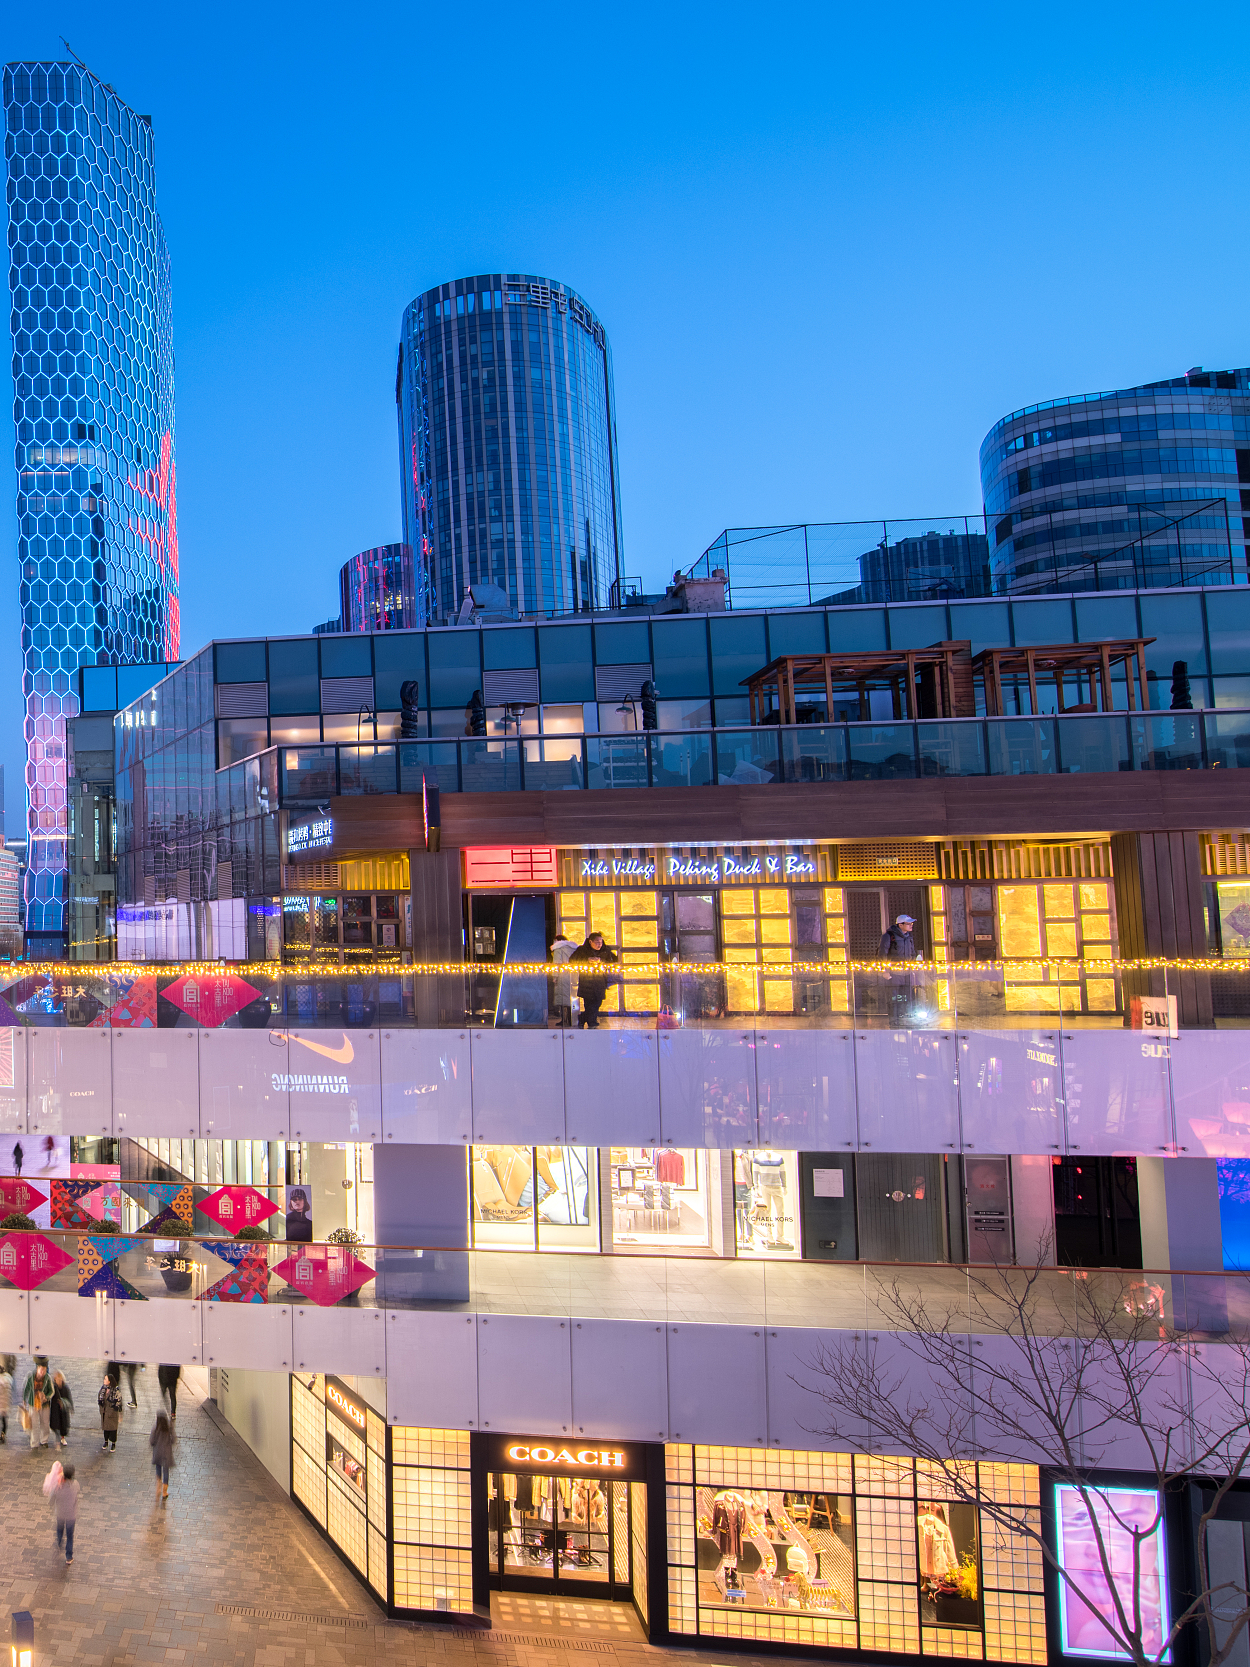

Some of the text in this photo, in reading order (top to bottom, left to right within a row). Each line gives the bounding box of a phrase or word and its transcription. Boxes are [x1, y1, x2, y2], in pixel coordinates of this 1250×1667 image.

[504, 281, 568, 313] 三里屯
[581, 856, 815, 881] Xihe Village Peking Duck & Bar
[328, 1386, 365, 1428] COACH
[509, 1446, 625, 1467] COACH
